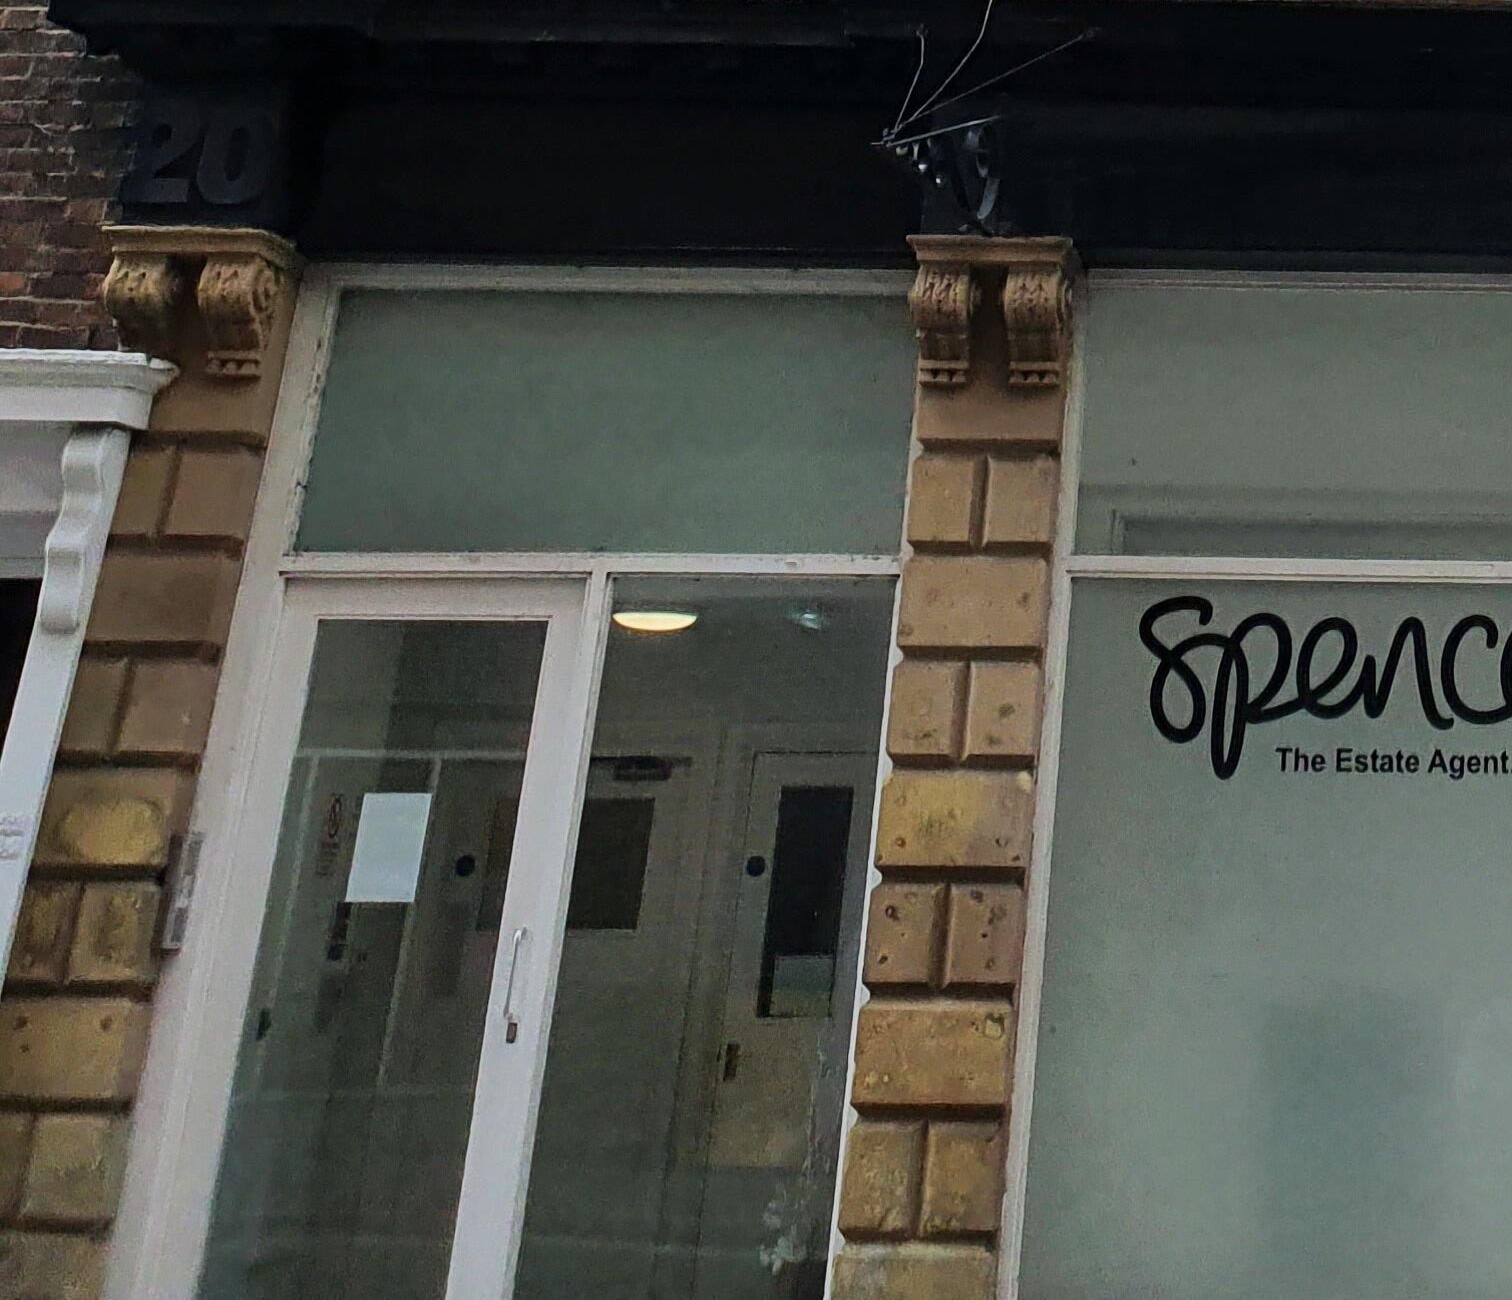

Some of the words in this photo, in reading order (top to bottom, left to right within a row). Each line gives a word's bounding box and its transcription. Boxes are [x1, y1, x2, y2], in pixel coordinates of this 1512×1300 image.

[119, 102, 275, 204] 20
[1275, 747, 1326, 773] The
[1336, 748, 1419, 774] Estate
